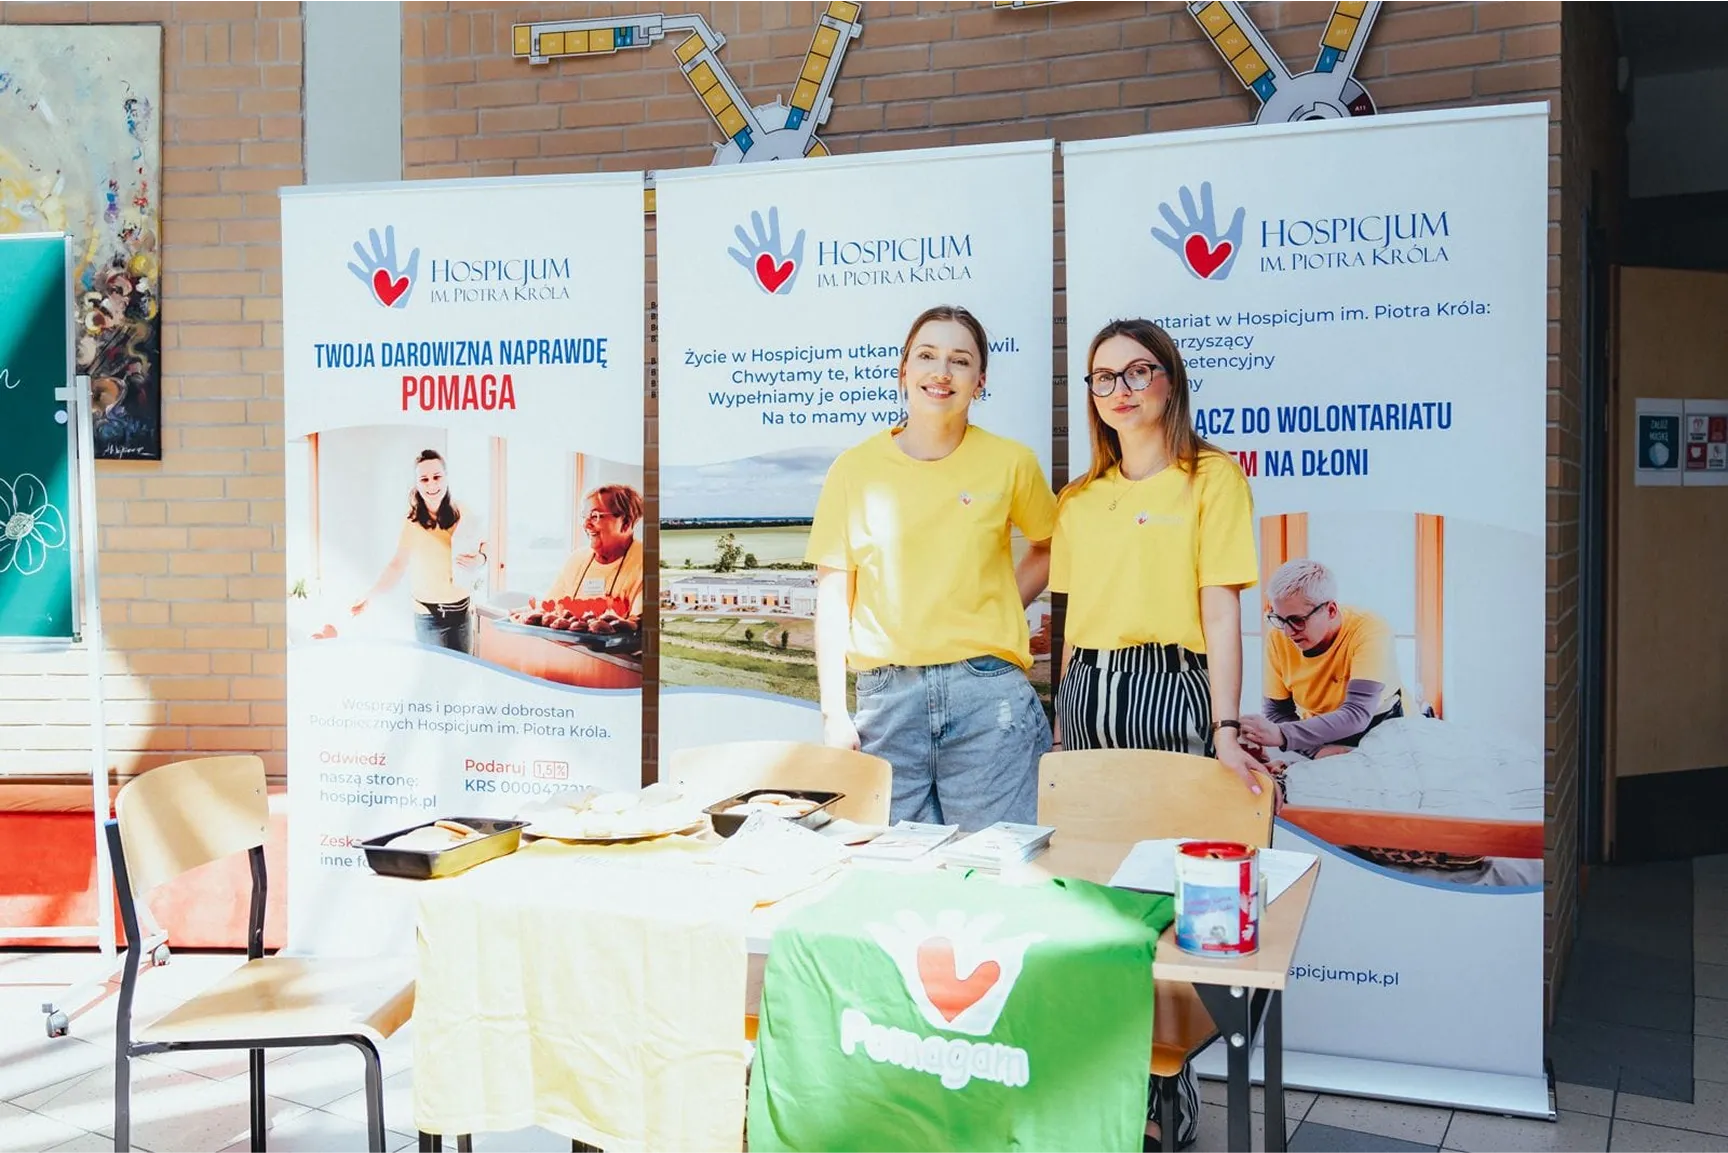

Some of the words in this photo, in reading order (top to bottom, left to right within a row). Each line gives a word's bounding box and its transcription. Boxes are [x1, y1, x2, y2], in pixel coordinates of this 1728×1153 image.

[1260, 210, 1450, 250] HOSPICJUM
[818, 234, 972, 268] HOSPICJUM
[1260, 256, 1286, 272] IM.
[1292, 252, 1365, 271] PIOTRA
[1372, 243, 1449, 265] KRÓLA
[432, 258, 570, 286] HOSPICJUM
[818, 273, 838, 288] IM.
[844, 270, 905, 287] PIOTRA
[908, 261, 972, 283] KRÓLA
[431, 290, 450, 303] IM.
[454, 287, 510, 302] PIOTRA
[514, 283, 570, 302] KRÓLA
[1216, 316, 1232, 327] w
[1238, 306, 1334, 328] Hospicjum
[1340, 304, 1369, 321] im.
[1375, 303, 1430, 320] Piotra
[1437, 300, 1491, 317] Króla:
[314, 342, 375, 368] TWOJA
[382, 340, 494, 367] DAROWIZNA
[500, 338, 608, 369] NAPRAWDĘ
[684, 348, 727, 366] Życie
[732, 352, 746, 364] w
[752, 346, 842, 364] Hospicjum
[988, 337, 1020, 352] wil.
[1174, 335, 1254, 351] arzyszący
[732, 368, 820, 386] Chwytamy
[828, 367, 848, 382] te,
[854, 365, 900, 380] które
[402, 374, 516, 411] POMAGA
[708, 386, 813, 407] Wypełniamy
[818, 387, 834, 404] je
[840, 386, 898, 404] opieką
[762, 412, 784, 425] Na
[790, 411, 806, 424] to
[812, 412, 866, 427] mamy
[1195, 408, 1235, 440] ĄCZ
[1242, 406, 1270, 434] DO
[1276, 402, 1452, 434] WOLONTARIATU
[1265, 450, 1294, 477] NA
[1302, 448, 1369, 476] DŁONI
[342, 698, 404, 715] Wesprzyj
[408, 702, 432, 713] nas
[444, 704, 497, 716] popraw
[502, 704, 574, 718] dobrostan
[418, 719, 493, 735] Hospicjum
[498, 722, 519, 735] im.
[524, 722, 565, 736] Piotra
[570, 726, 611, 738] Króla.
[465, 759, 526, 776] Podaruj
[320, 772, 362, 786] naszą
[465, 779, 496, 792] KRS
[320, 790, 436, 809] hospicjumpk.pl
[320, 834, 362, 848] Zesk
[320, 852, 352, 867] inne
[1289, 964, 1398, 987] spicjumpk.pl
